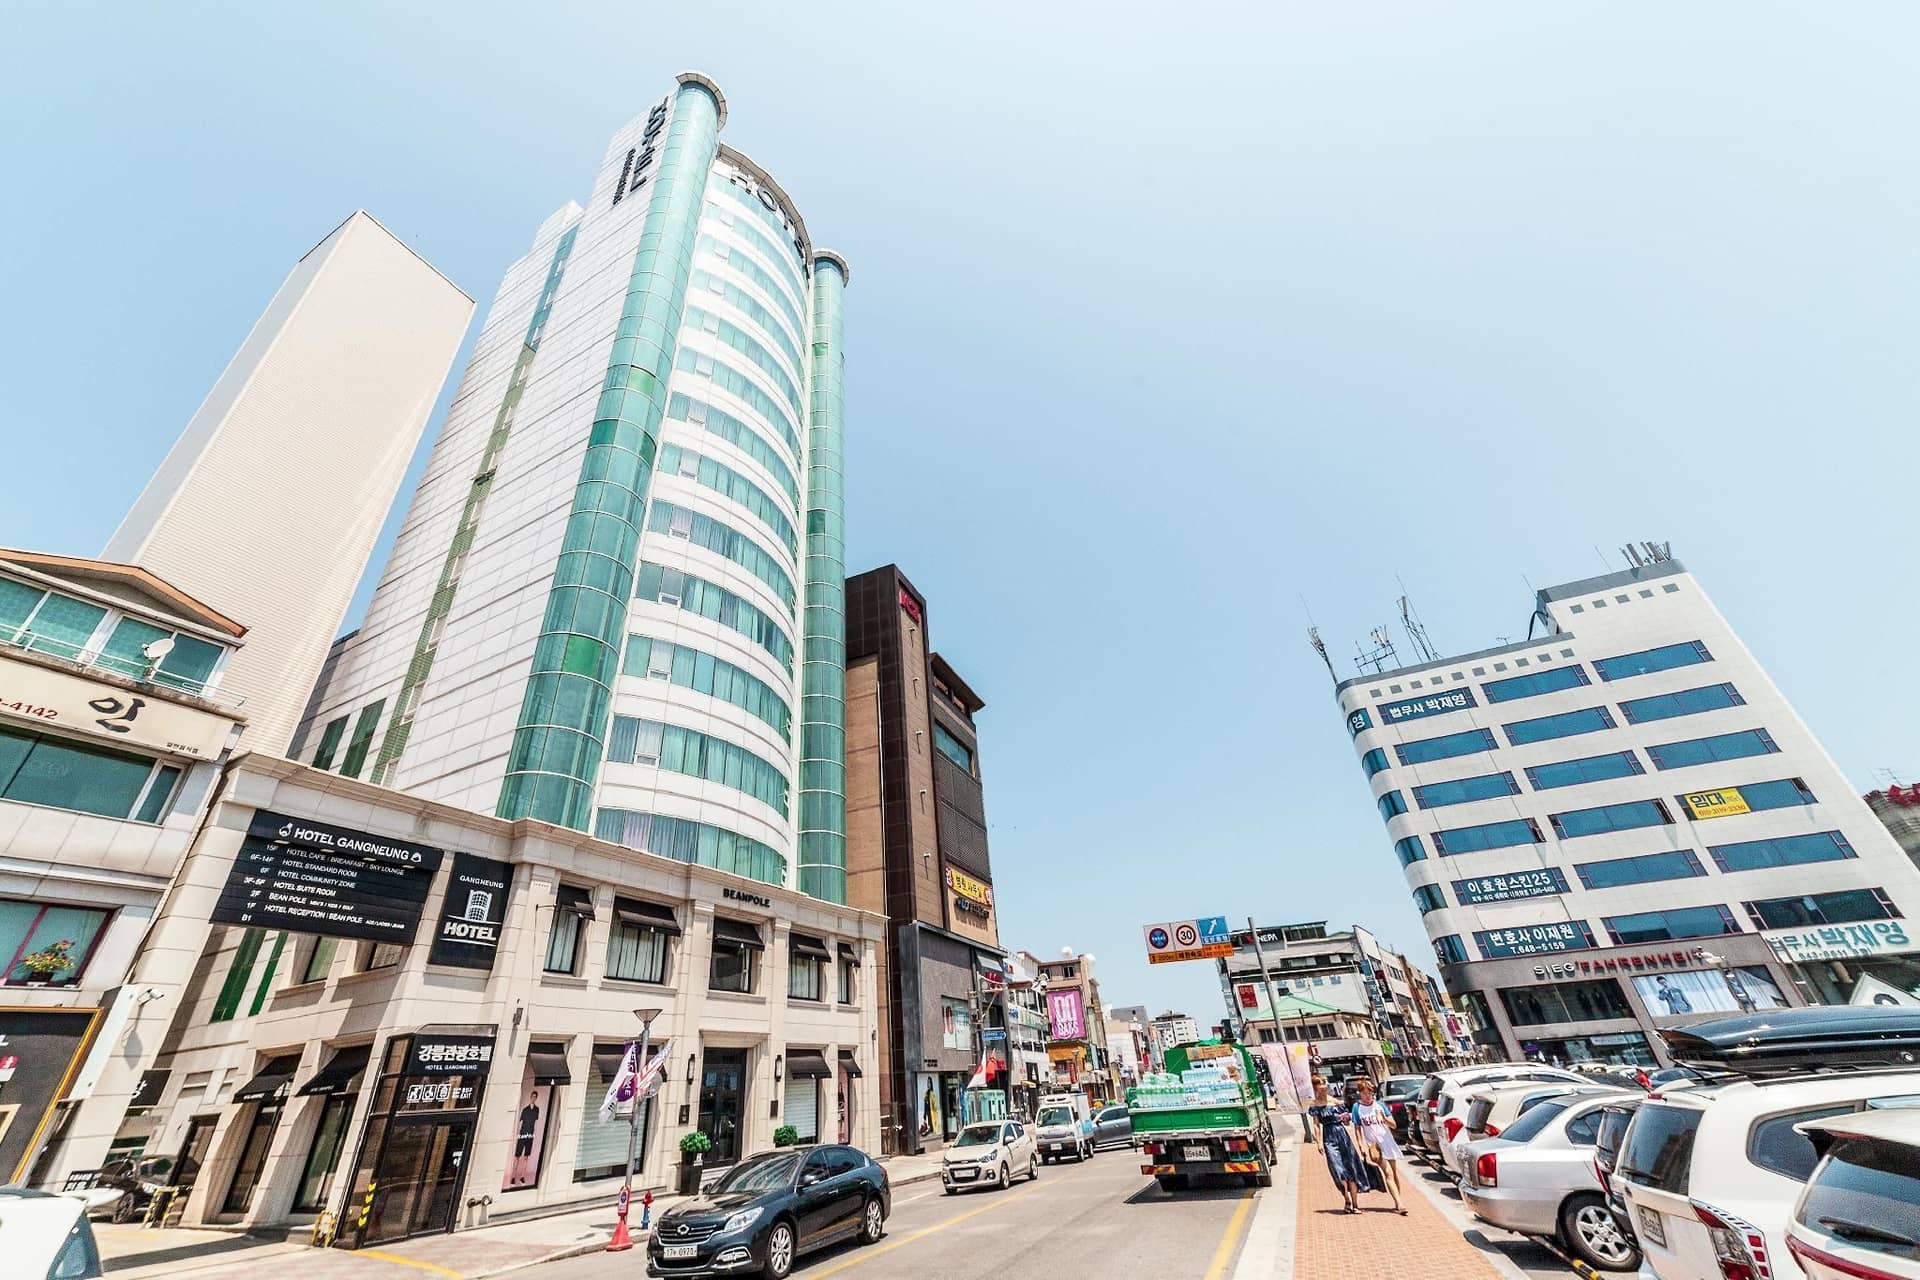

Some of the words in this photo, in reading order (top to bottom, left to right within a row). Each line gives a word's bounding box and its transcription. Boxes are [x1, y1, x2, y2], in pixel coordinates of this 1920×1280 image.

[0, 697, 59, 720] -4142
[1389, 702, 1425, 719] 법무사
[1425, 693, 1467, 711] 박재영
[1690, 792, 1727, 808] 임대
[294, 827, 335, 846] HOTEL
[337, 837, 410, 861] GANGNEUNG
[282, 859, 304, 868] HOTEL
[304, 863, 338, 875] STANDARD
[338, 868, 358, 878] ROOM
[286, 848, 308, 858] HOTEL
[330, 856, 366, 869] BREAKFAST
[369, 864, 382, 872] SKY
[381, 866, 405, 876] LOUNGE
[273, 881, 296, 891] HOTEL
[296, 885, 316, 894] SUITE
[316, 888, 337, 897] ROOM
[277, 870, 300, 880] HOTEL
[300, 874, 339, 886] COMMUNITY
[338, 880, 357, 889] ZONE
[459, 875, 504, 889] GANGNEUNG
[249, 889, 262, 897] 2F
[269, 892, 288, 903] BEAN
[287, 895, 308, 905] POLE
[723, 887, 771, 908] BEANPOLE
[264, 904, 288, 914] HOTEL
[287, 907, 326, 918] RECEPTION
[328, 913, 347, 923] BEAN
[346, 916, 364, 924] POLE
[443, 921, 497, 941] HOTEL
[1180, 930, 1193, 941] 30
[1257, 933, 1278, 943] NEPA
[1489, 929, 1532, 947] 변호사
[1532, 923, 1576, 942] 이재원
[1817, 921, 1910, 950] 박재영
[1533, 961, 1576, 976] SIEG
[417, 1044, 493, 1062] 강릉관광호텔
